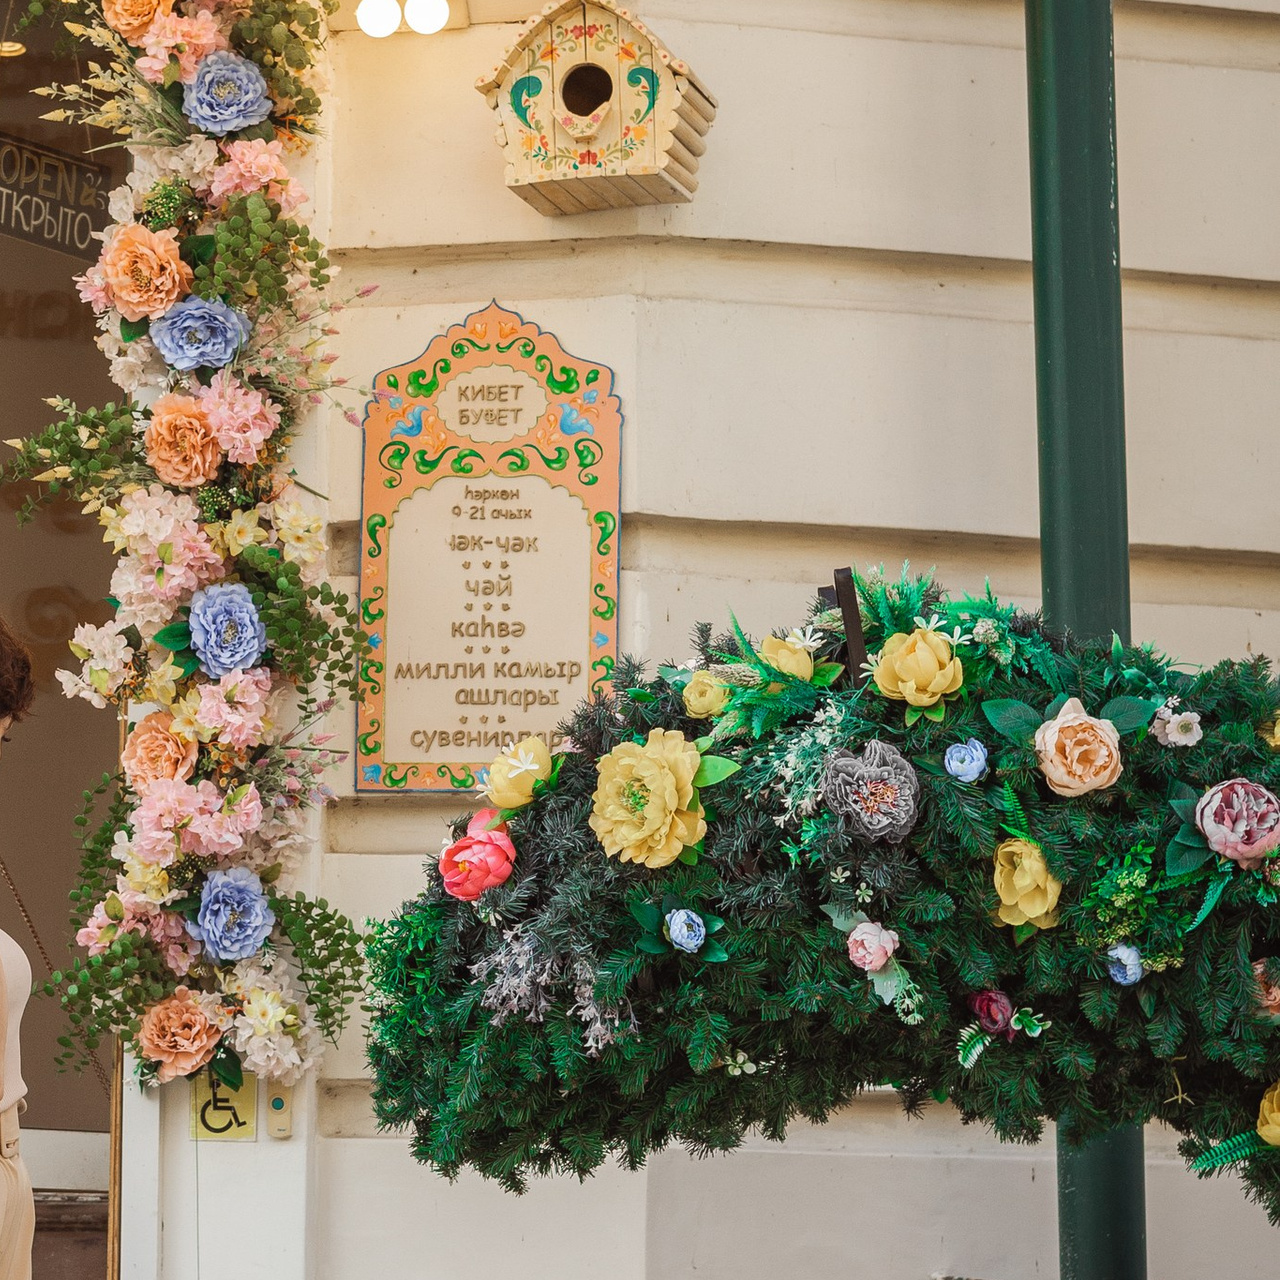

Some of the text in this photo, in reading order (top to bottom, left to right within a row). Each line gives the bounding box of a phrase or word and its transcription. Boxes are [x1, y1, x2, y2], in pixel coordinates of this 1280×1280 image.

[457, 384, 524, 402] КИБЕТ
[458, 407, 523, 427] БУФЕТ
[451, 505, 532, 520] 9-21 ачык
[394, 660, 582, 684] милли камыр
[455, 688, 560, 713] ашлары
